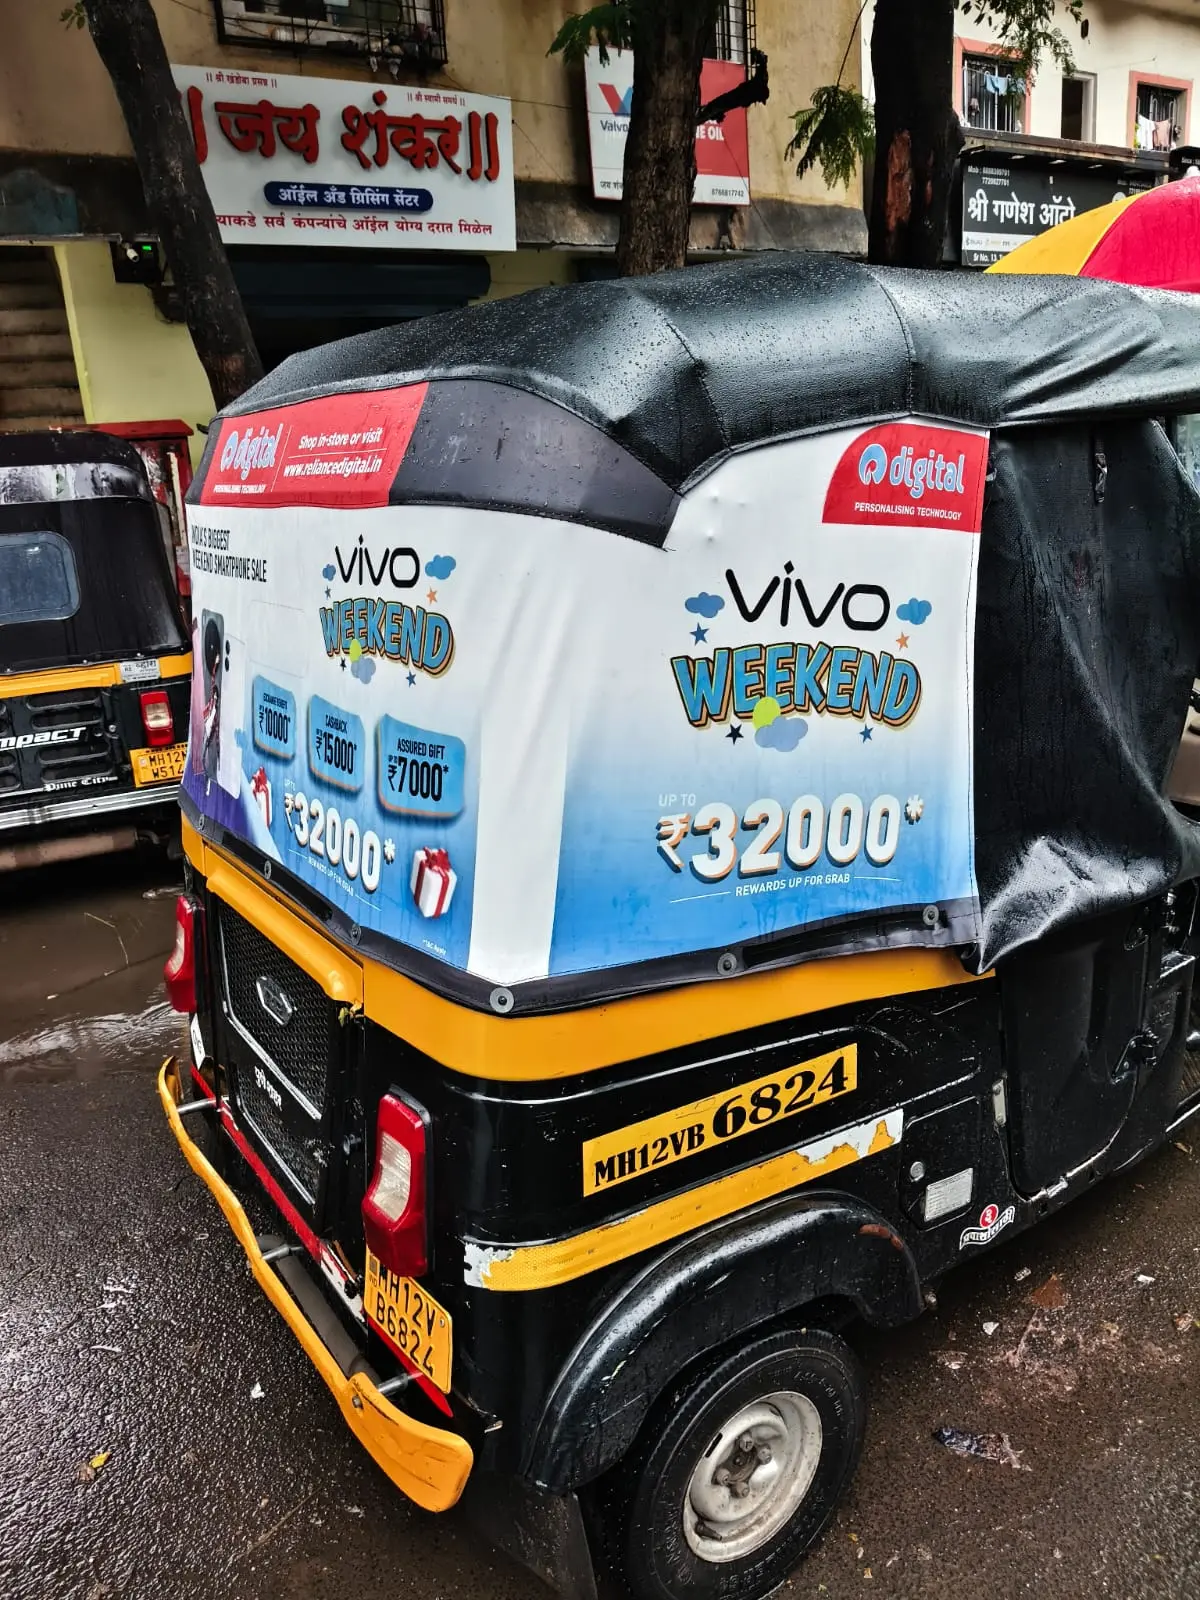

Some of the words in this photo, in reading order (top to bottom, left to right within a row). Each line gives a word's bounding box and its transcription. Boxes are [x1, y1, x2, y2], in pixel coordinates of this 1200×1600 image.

[214, 99, 320, 164] जय
[341, 90, 463, 175] शंकर
[600, 119, 629, 133] Valvo
[707, 125, 725, 141] OIL
[278, 184, 318, 205] ऑईल
[323, 186, 347, 204] अँड
[393, 188, 420, 207] सेंटर
[968, 188, 989, 222] श्री
[992, 191, 1036, 224] गणेश
[263, 211, 286, 228] सर्व
[352, 216, 388, 234] ऑईल
[426, 222, 453, 234] दरात
[298, 434, 317, 450] Shop
[318, 432, 350, 447] in-store
[349, 432, 362, 446] or
[361, 427, 383, 444] visit
[283, 455, 382, 477] www.reliancedigital.in
[889, 446, 965, 498] digital
[854, 502, 915, 516] PERSONALISING
[916, 506, 962, 521] TECHNOLOGY
[214, 554, 250, 580] SMARTPHONE
[251, 558, 267, 583] SALE
[334, 533, 420, 588] vivo
[725, 560, 891, 632] vivo
[319, 597, 456, 679] WEEKEND
[669, 641, 923, 730] WEEKEND
[325, 714, 348, 734] CASHBACK
[397, 737, 427, 756] ASSURED
[428, 743, 446, 760] GIFT
[658, 794, 677, 807] UP
[680, 793, 697, 807] TO
[735, 879, 786, 897] REWARDS
[788, 876, 802, 889] UP
[804, 874, 823, 886] FOR
[825, 872, 851, 885] GRAB
[594, 1122, 705, 1188] MH12VB
[711, 1055, 850, 1138] 6824
[376, 1291, 434, 1378] B6824
